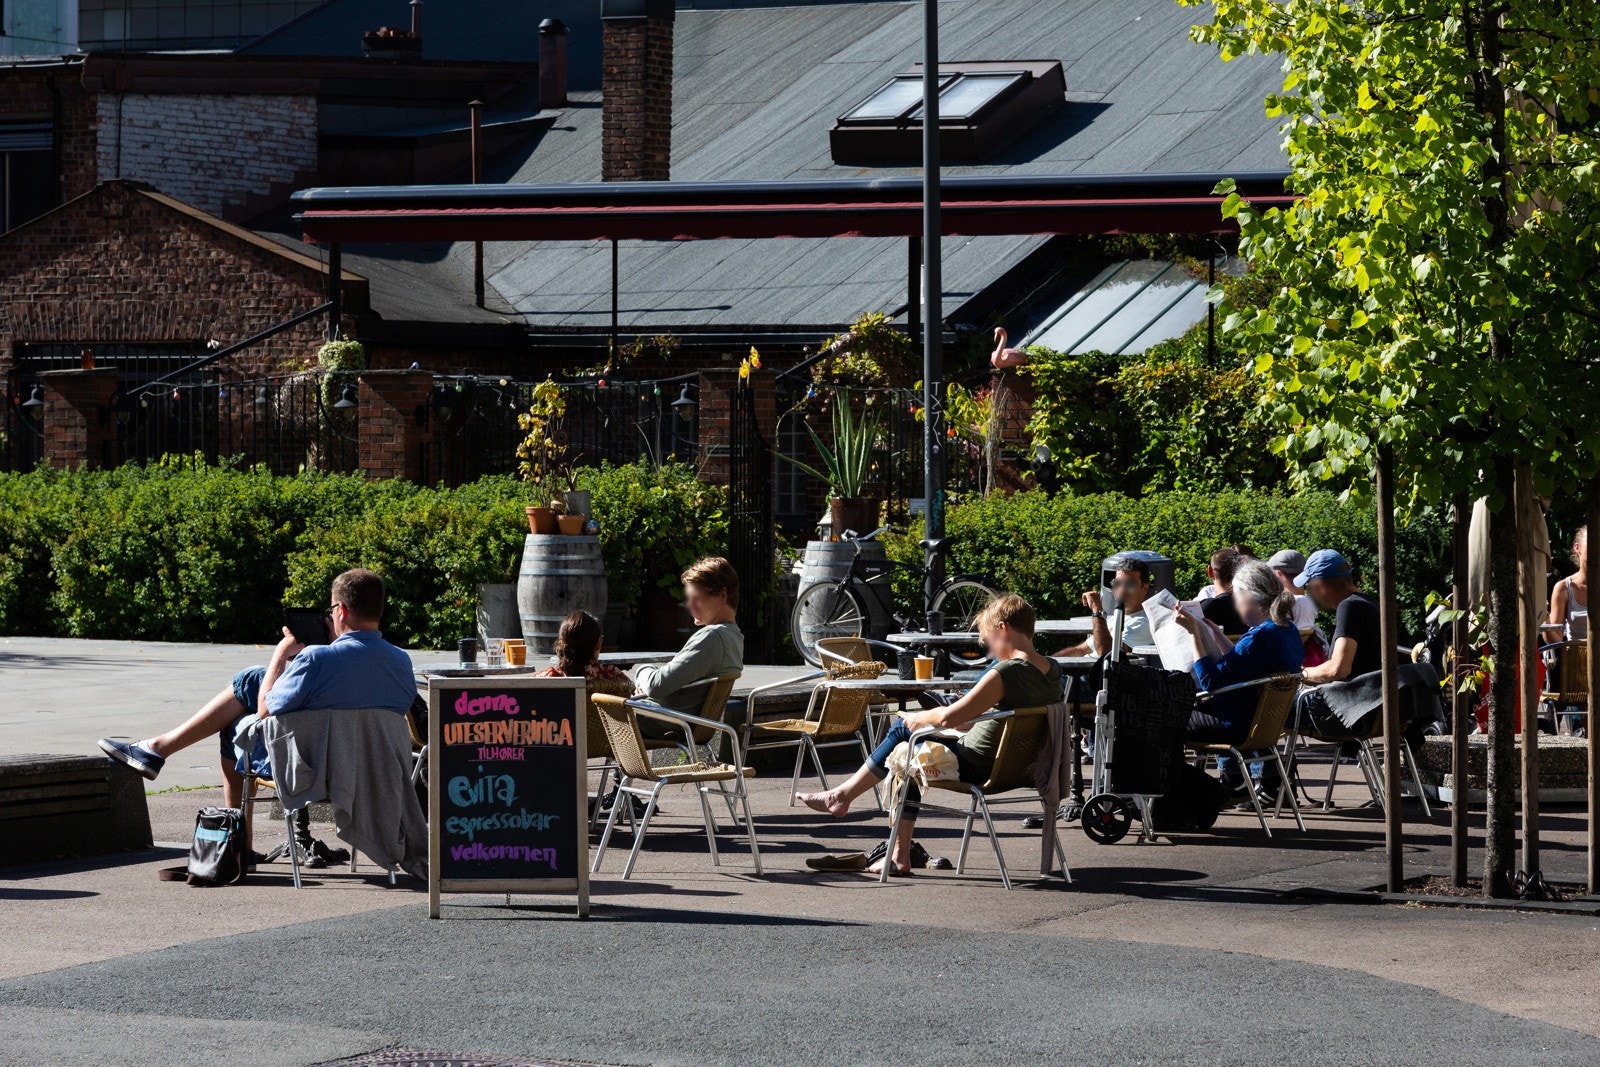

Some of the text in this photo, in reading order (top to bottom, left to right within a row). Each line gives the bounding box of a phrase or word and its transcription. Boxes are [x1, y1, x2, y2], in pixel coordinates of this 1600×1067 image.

[455, 691, 519, 715] denne
[445, 808, 560, 841] espressobar
[450, 843, 558, 870] velkommen
